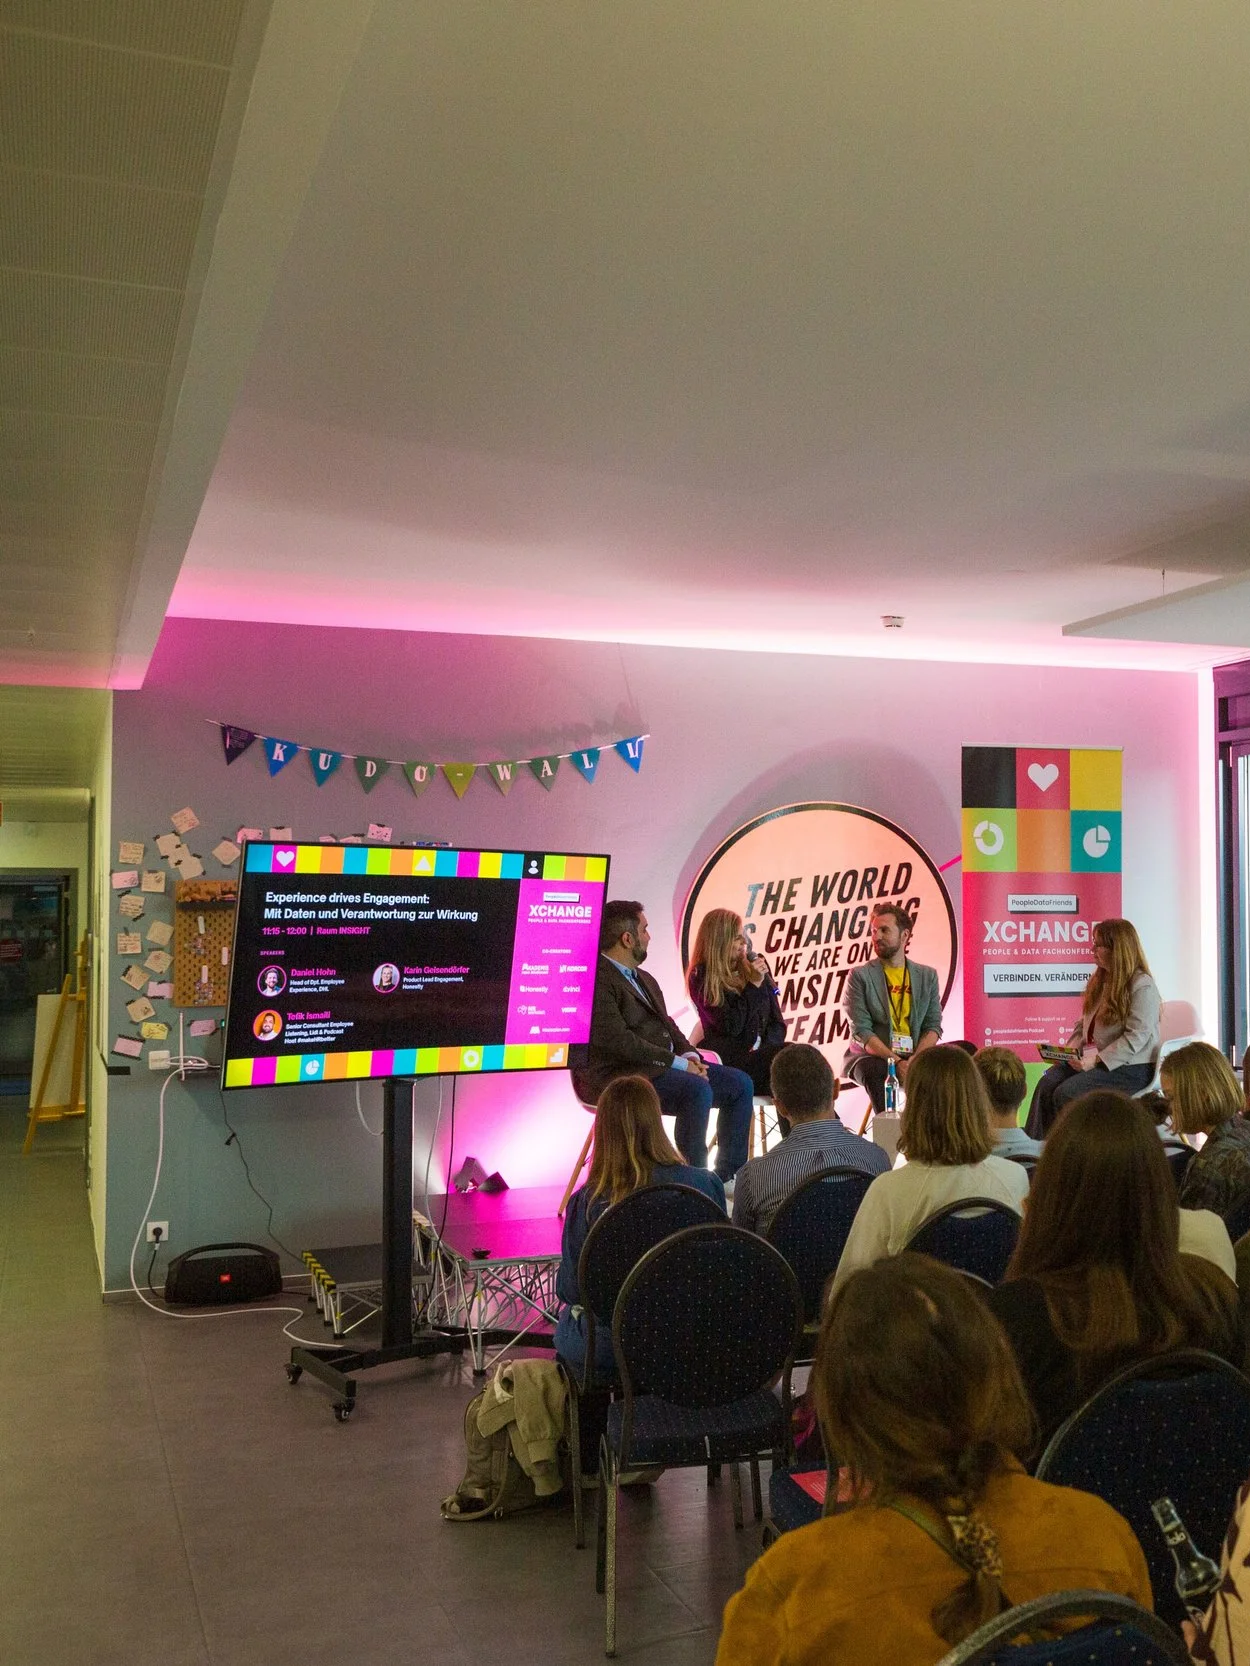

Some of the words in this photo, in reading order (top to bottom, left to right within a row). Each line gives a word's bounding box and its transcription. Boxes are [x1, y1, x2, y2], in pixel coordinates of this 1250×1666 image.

[745, 878, 802, 918] THE
[810, 862, 913, 909] WORLD
[265, 892, 327, 904] Experience
[329, 892, 361, 903] drives
[363, 893, 430, 905] Engagement:
[1012, 899, 1073, 908] PeopleDataFriends
[263, 908, 282, 919] Mit
[284, 908, 316, 919] Daten
[318, 908, 339, 919] und
[341, 909, 416, 921] Verantwortung
[418, 911, 434, 919] zur
[436, 910, 479, 922] Wirkung
[528, 905, 592, 917] XCHANGE
[262, 927, 280, 935] 11:15
[286, 927, 307, 935] 12:00
[316, 927, 338, 935] Raum
[339, 926, 371, 935] INSIGHT
[765, 897, 921, 954] CHANGG
[774, 953, 802, 977] WE
[805, 946, 843, 972] ARE
[847, 941, 873, 964] ON
[291, 968, 315, 976] Daniel
[993, 973, 1043, 982] VERBINDEN.
